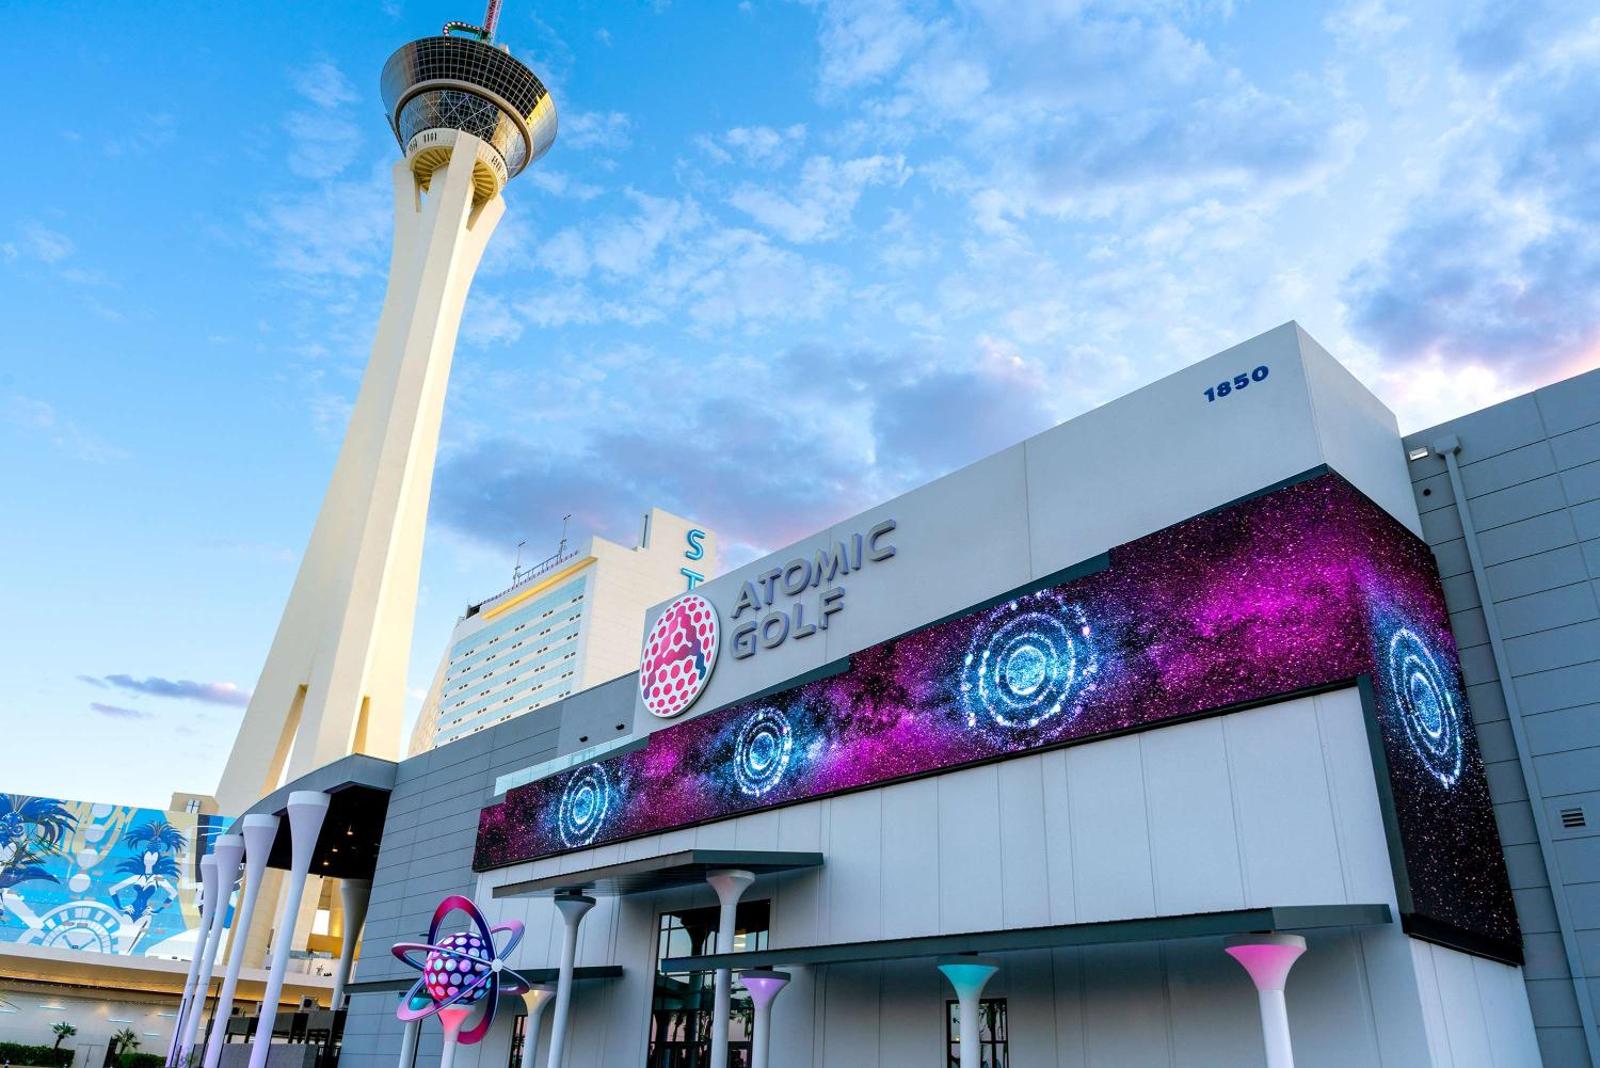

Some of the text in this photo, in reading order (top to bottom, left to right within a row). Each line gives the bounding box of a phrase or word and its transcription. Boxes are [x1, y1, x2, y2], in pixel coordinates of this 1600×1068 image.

[1203, 365, 1269, 402] 1850
[730, 519, 896, 618] ATOMIC
[730, 586, 845, 660] GOLF
